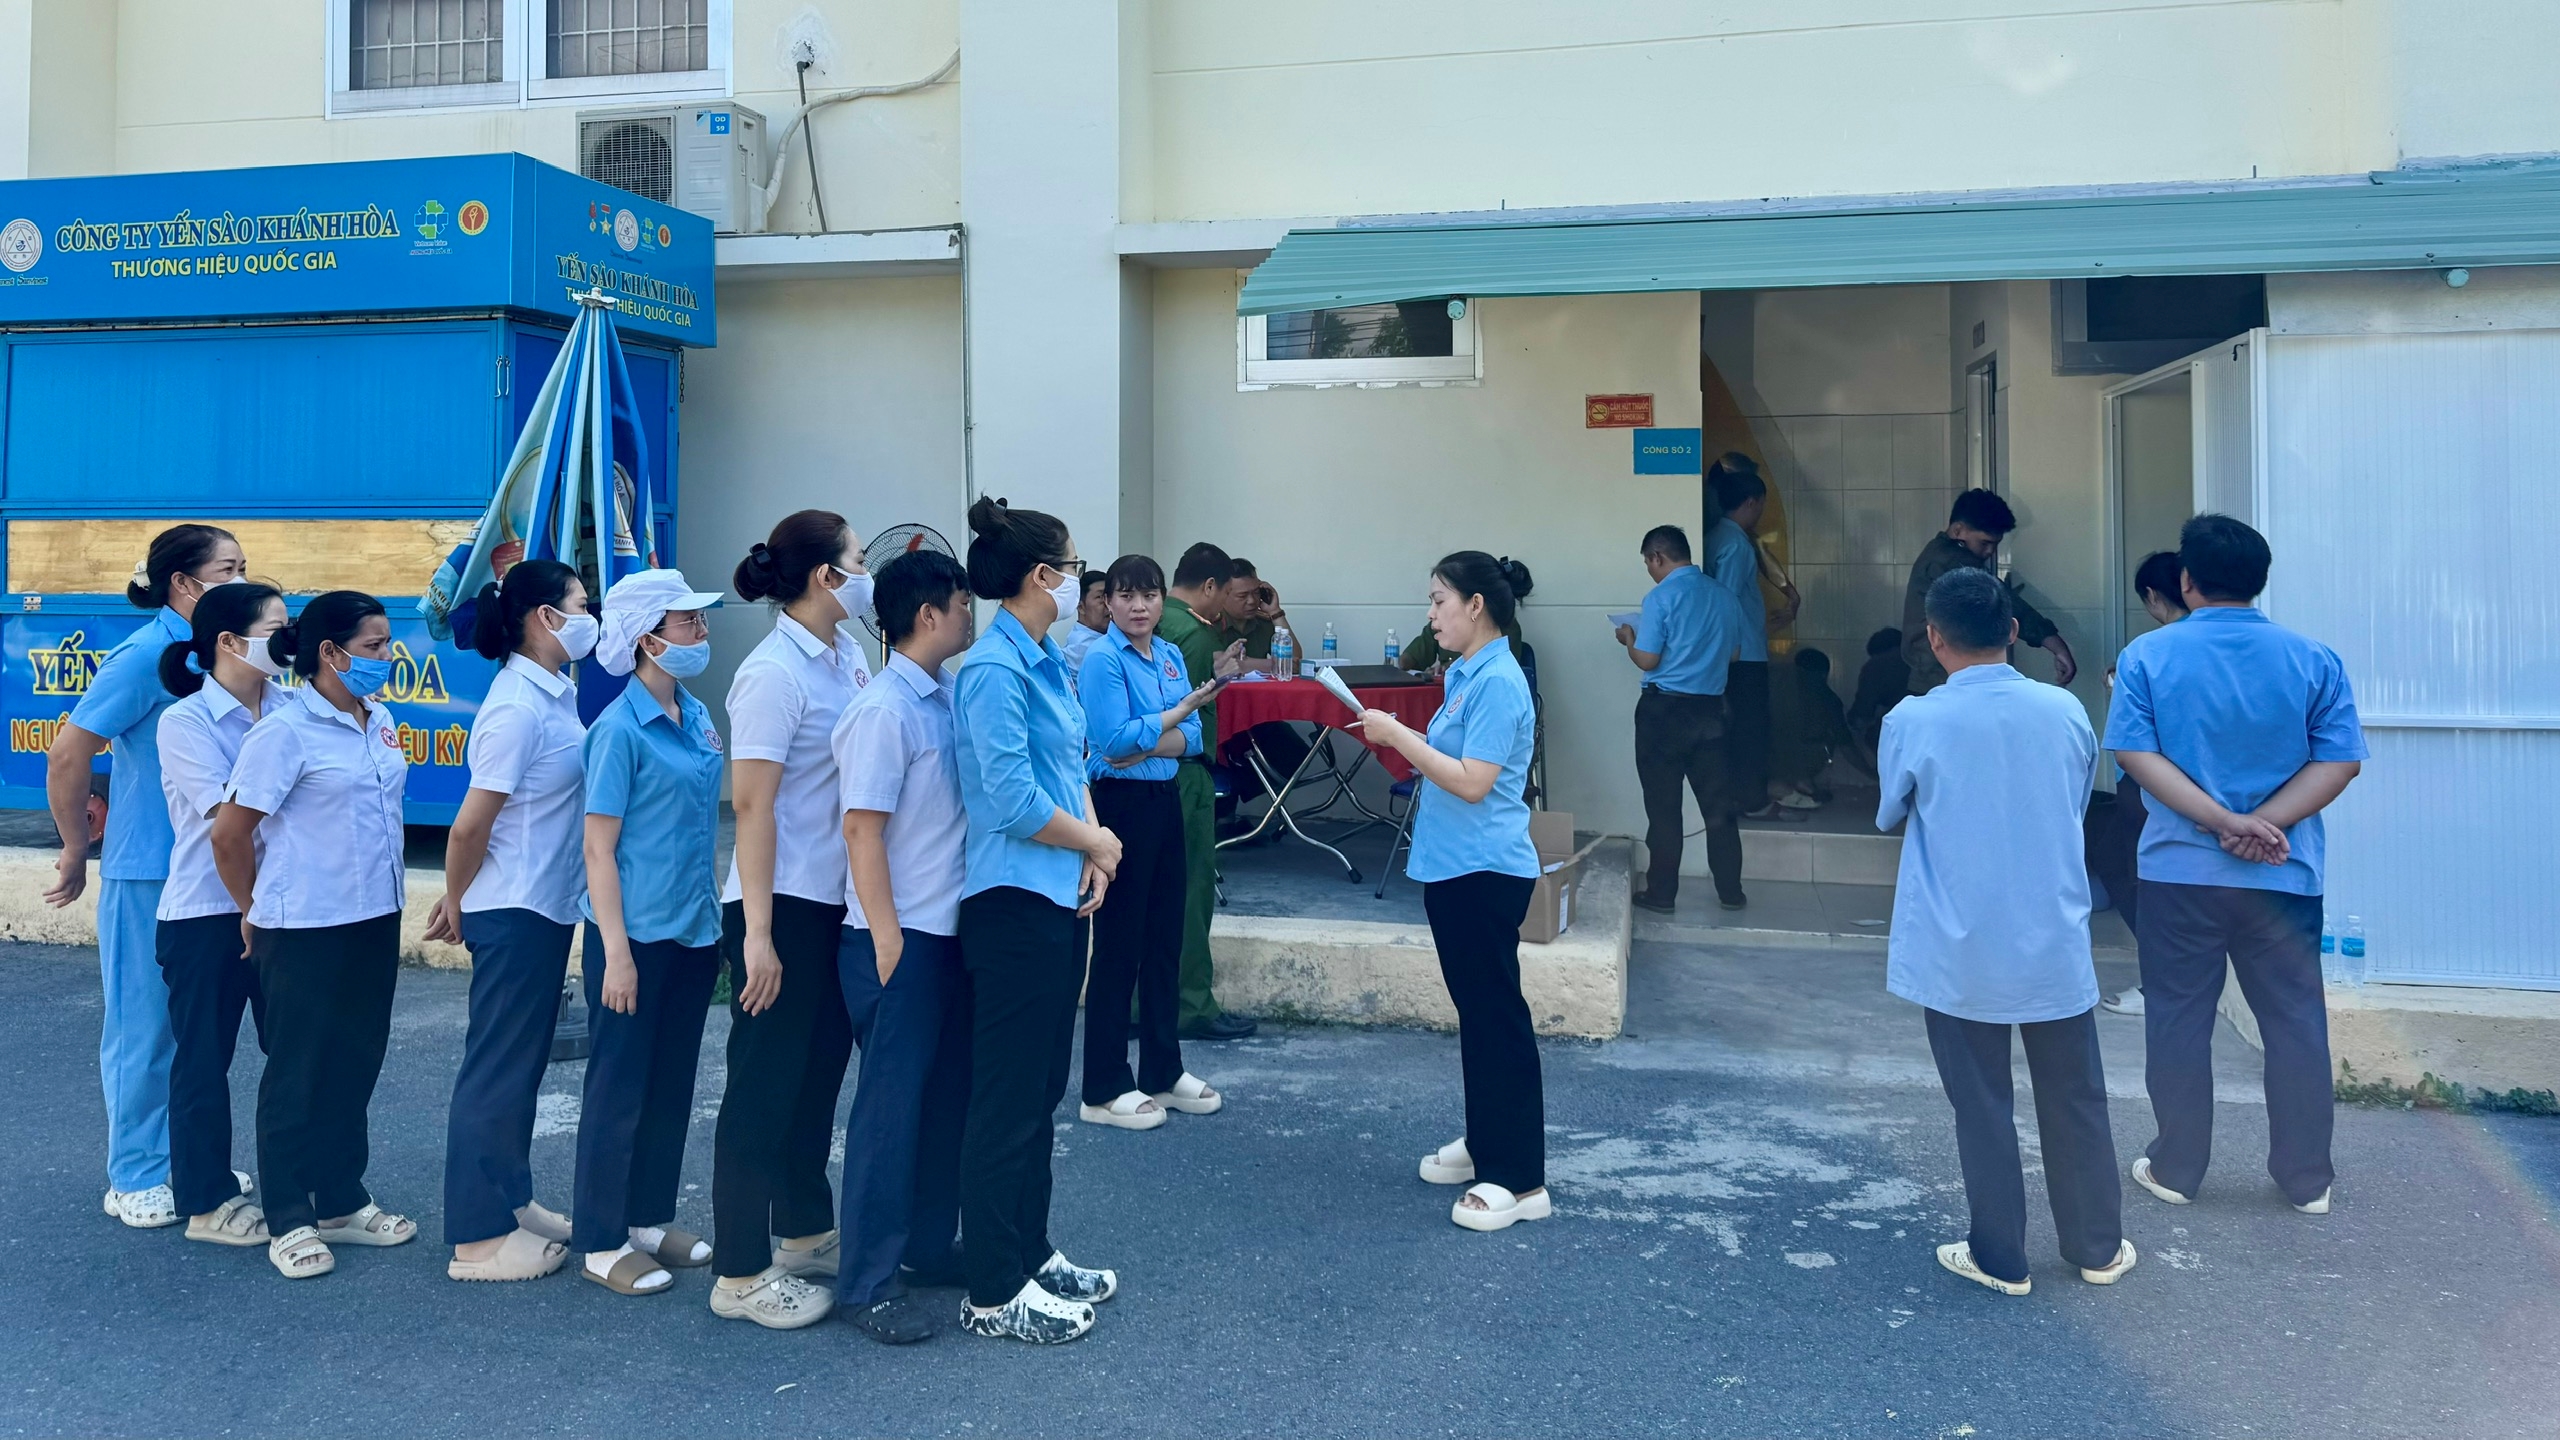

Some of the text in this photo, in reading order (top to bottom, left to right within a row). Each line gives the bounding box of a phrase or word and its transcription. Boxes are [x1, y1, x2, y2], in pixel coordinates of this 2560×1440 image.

[55, 203, 400, 252] CÔNG TY YẾN SÀO KHÁNH HÒA
[111, 248, 337, 279] THƯƠNG HIỆU QUỐC GIA
[555, 252, 587, 284] YẾN
[590, 260, 618, 290] SÀO
[620, 272, 670, 304] KHÁNH
[672, 281, 699, 310] HÒA
[616, 298, 692, 327] HIỆU QUỐC GIA
[1685, 446, 1692, 454] 2
[379, 641, 449, 703] ÒA
[434, 723, 468, 766] KỲ
